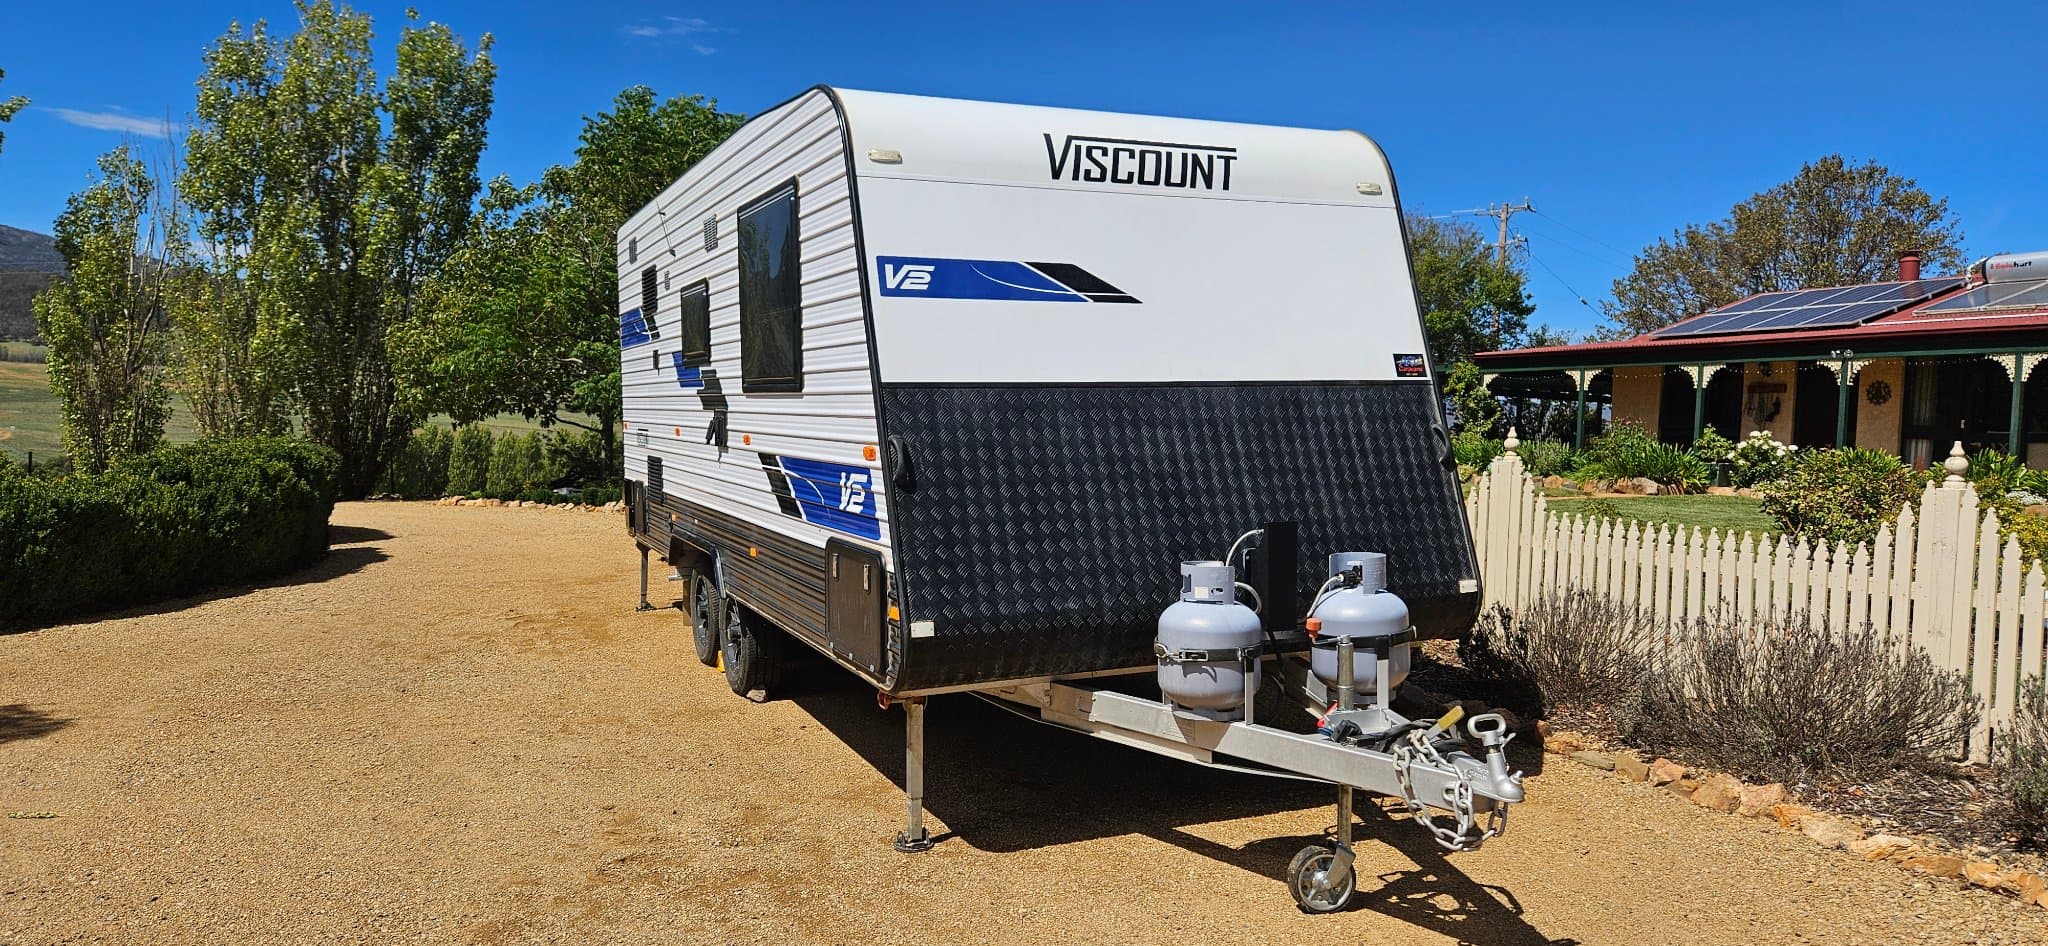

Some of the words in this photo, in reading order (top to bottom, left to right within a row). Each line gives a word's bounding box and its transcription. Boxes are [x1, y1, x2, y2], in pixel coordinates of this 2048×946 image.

[1043, 132, 1238, 191] VISCOUNT
[884, 263, 936, 290] V2
[838, 471, 869, 514] V2
